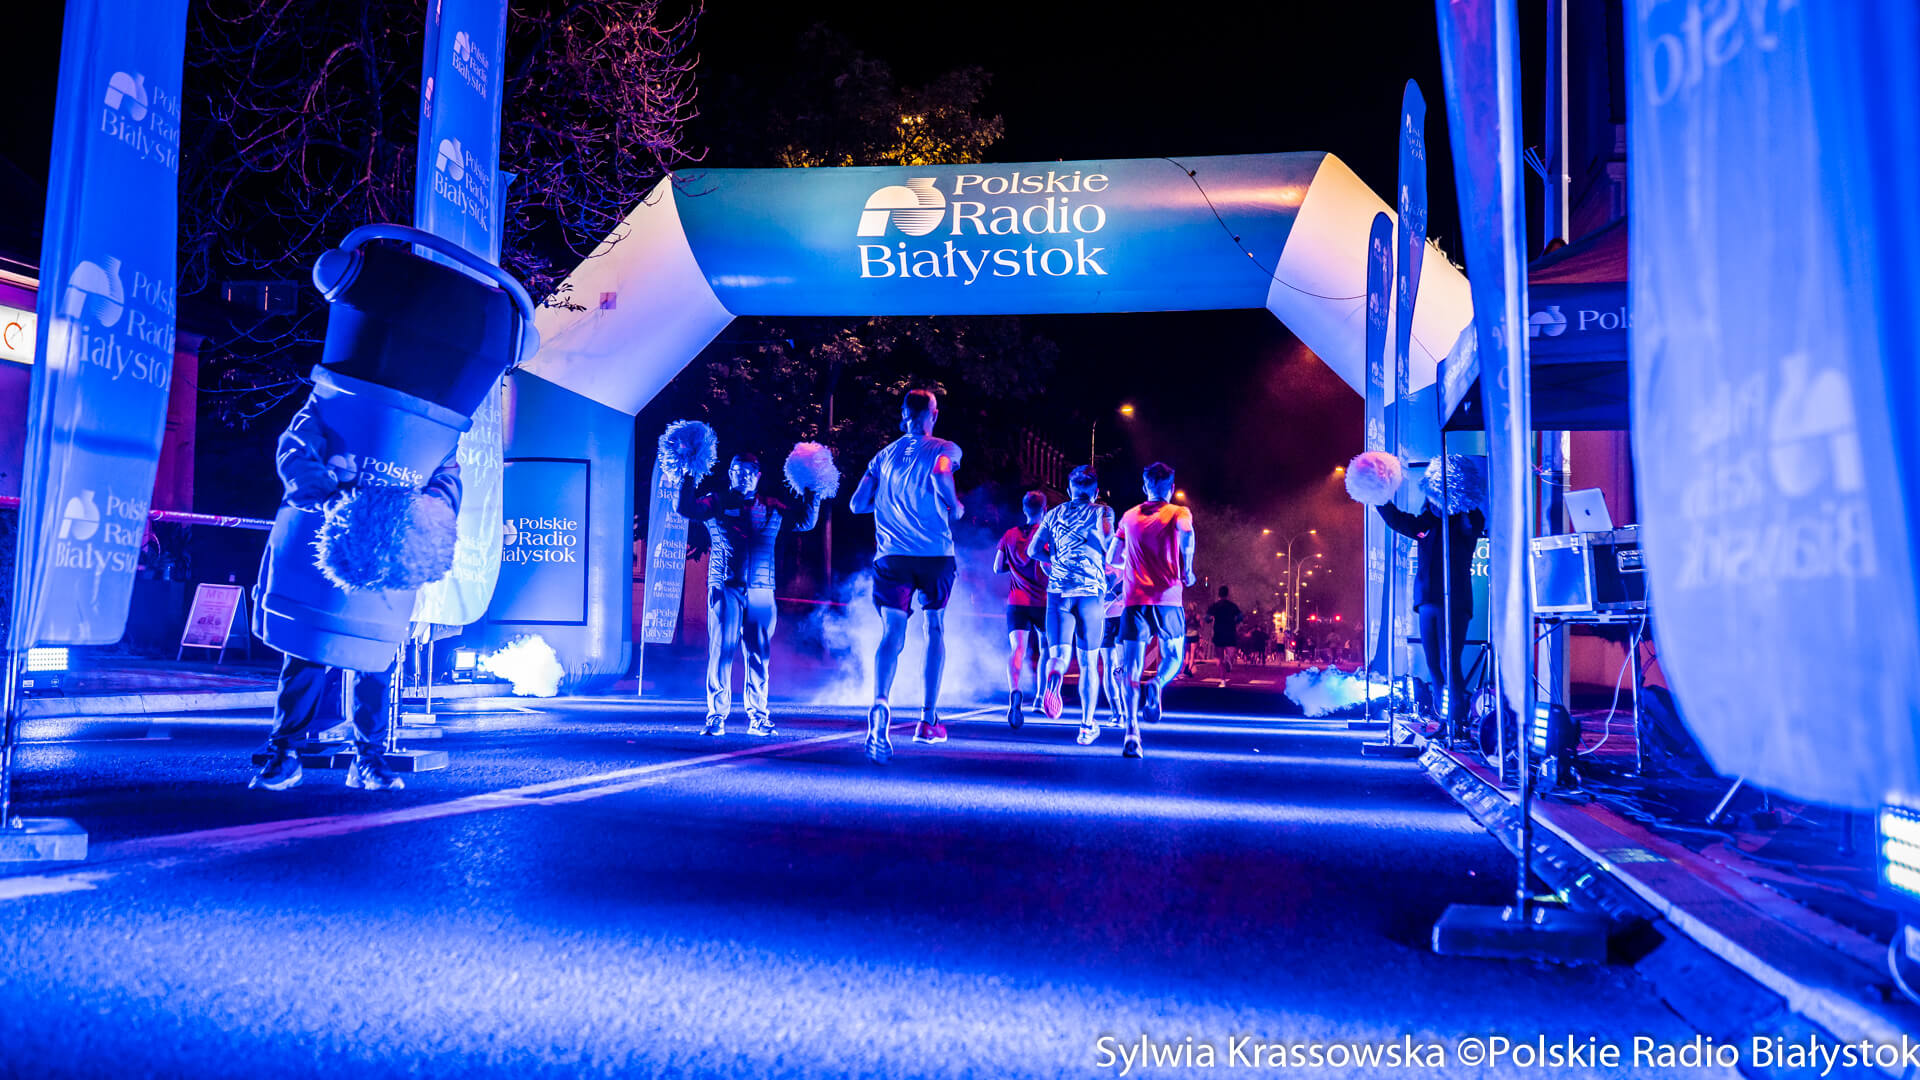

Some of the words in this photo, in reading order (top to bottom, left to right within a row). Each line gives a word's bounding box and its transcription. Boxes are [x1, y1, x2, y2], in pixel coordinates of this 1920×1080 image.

[952, 170, 1110, 196] Polskie
[948, 196, 1108, 236] Radio
[856, 237, 1109, 286] Białystok
[362, 456, 424, 485] Polskie
[519, 516, 577, 531] Polskie
[519, 530, 577, 547] Radio
[502, 546, 577, 566] iałystok
